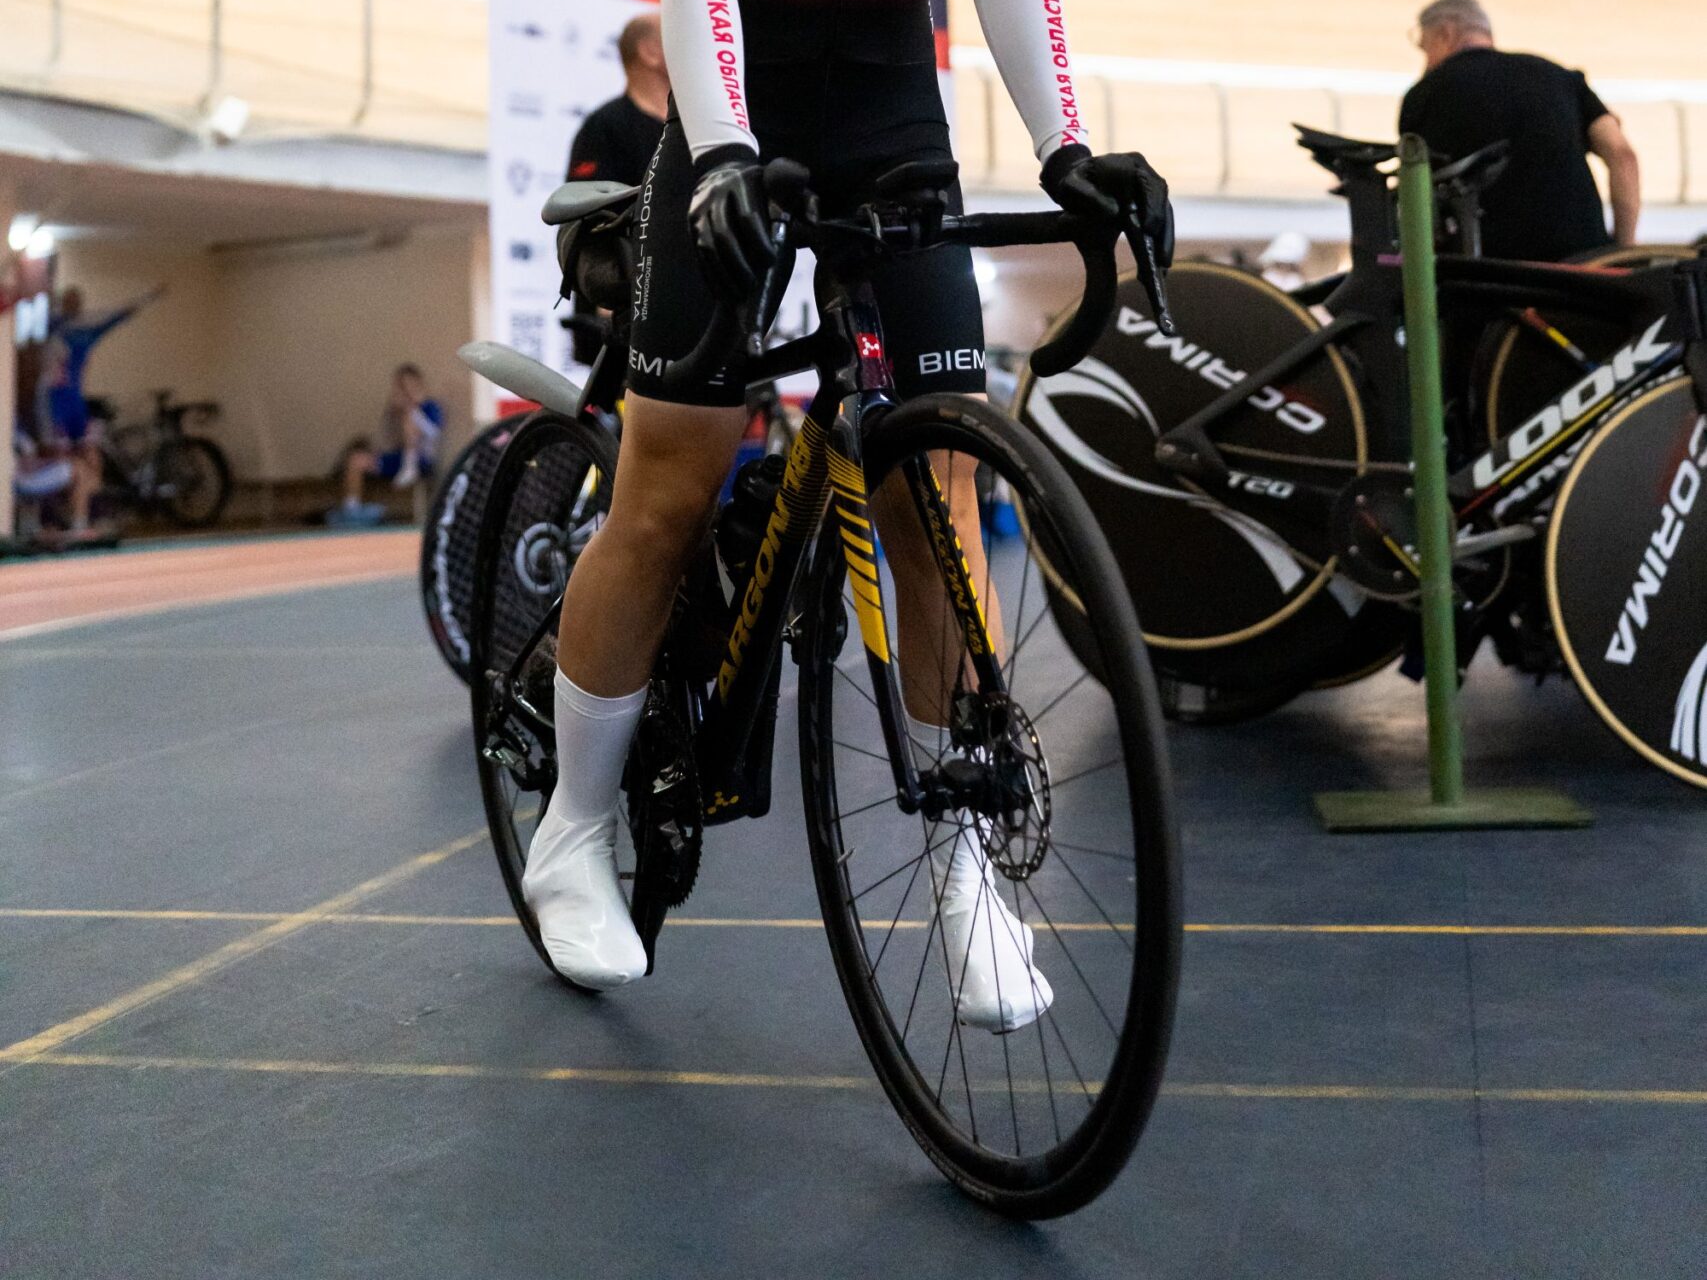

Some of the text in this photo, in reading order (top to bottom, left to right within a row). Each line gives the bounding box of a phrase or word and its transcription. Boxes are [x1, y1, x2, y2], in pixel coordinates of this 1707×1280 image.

[1056, 73, 1081, 147] УЬСКАЯ
[1473, 314, 1672, 489] LOOK
[718, 493, 793, 707] ARGON
